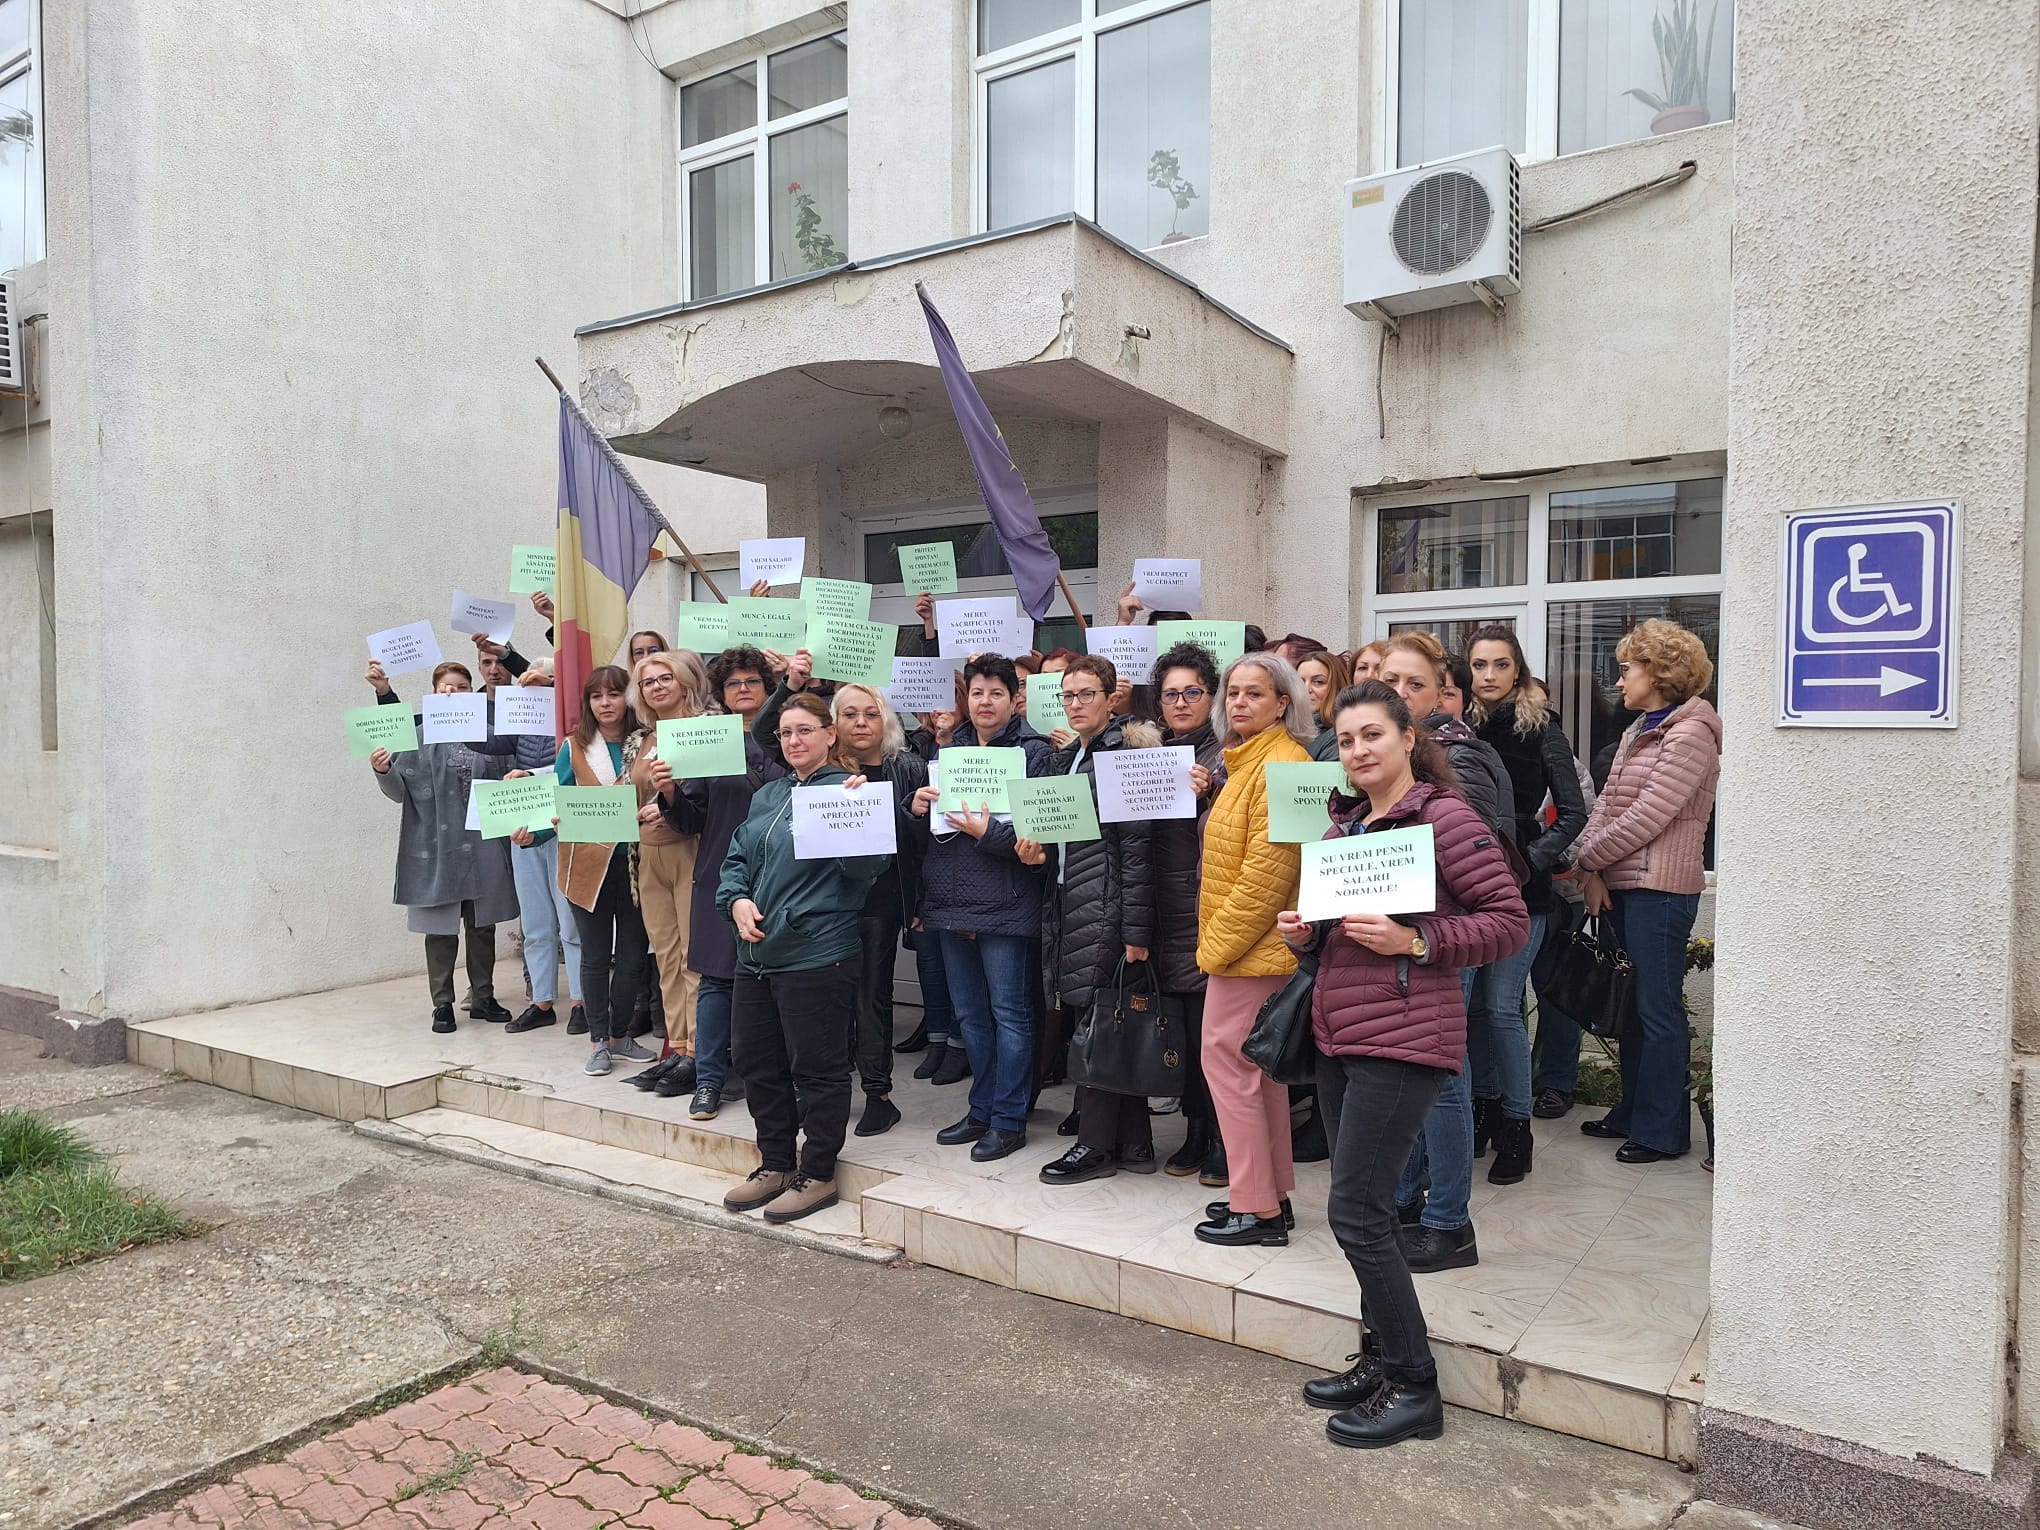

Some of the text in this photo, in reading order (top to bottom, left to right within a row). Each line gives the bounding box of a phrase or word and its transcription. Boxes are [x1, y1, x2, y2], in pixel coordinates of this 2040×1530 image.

[469, 605, 494, 614] PROTEST
[828, 620, 854, 628] SUNTEM
[958, 627, 997, 636] NICIODATĂ
[393, 648, 416, 657] SALARII
[828, 644, 866, 653] CATEGORIE
[828, 660, 862, 668] SECTORUL
[1114, 753, 1144, 761] SUNTEM
[1115, 760, 1169, 770] DISCRIMINATĂ
[948, 768, 1007, 776] SACRIFICAȚI ȘI
[1122, 768, 1173, 779] NESUSȚINUTĂ
[954, 776, 998, 784] NICIODATĂ
[1121, 779, 1164, 787] CATEGORIE
[1037, 787, 1056, 796] FĂRĂ
[1122, 787, 1161, 796] SALARIAȚI
[1297, 785, 1332, 794] PROTES
[809, 801, 838, 809] DORIM
[840, 799, 851, 808] SĂ
[853, 799, 865, 807] NE
[1023, 795, 1075, 806] DISCRIMINĂRI
[1125, 796, 1164, 804] SECTORUL
[1293, 797, 1328, 805] SPONTA
[1038, 806, 1061, 814] ÎNTRE
[1131, 803, 1172, 812] SĂNĂTATE!
[820, 809, 871, 820] APRECIATĂ
[1025, 815, 1067, 824] CATEGORII
[828, 821, 864, 830] MUNCA!
[1032, 823, 1075, 832] PERSONAL!
[1321, 843, 1412, 864] NU VREM PENSII
[1319, 856, 1415, 876] SPECIALE, VREM
[1343, 872, 1390, 885] SALARII
[1335, 884, 1398, 897] NORMALE!
